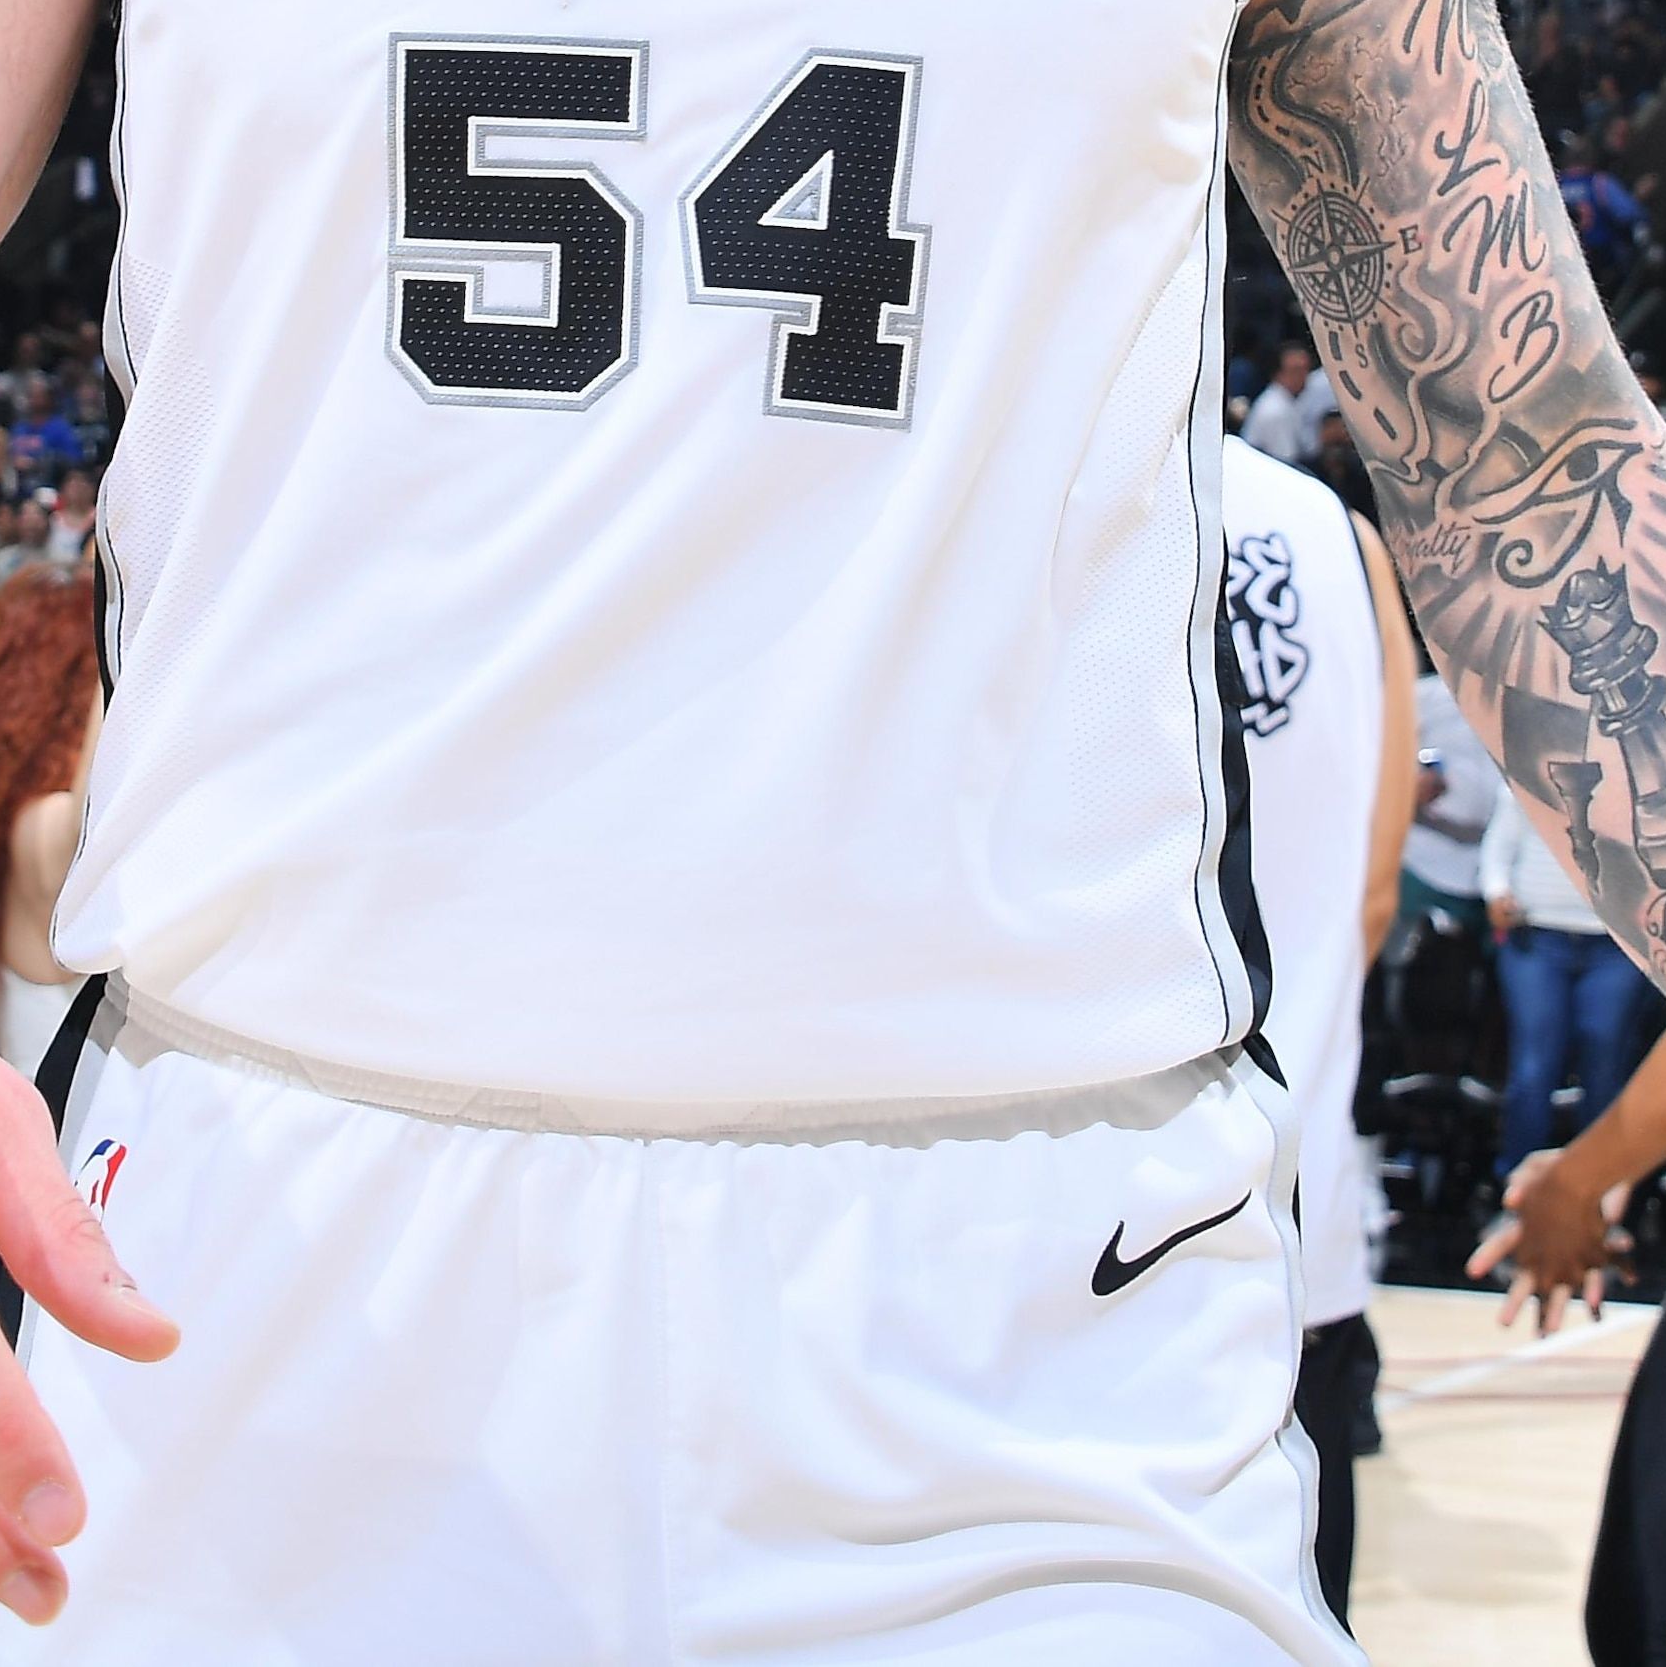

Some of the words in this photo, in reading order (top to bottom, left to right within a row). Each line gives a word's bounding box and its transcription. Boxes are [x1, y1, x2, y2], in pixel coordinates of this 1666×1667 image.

[384, 32, 931, 432] 54
[1399, 225, 1422, 254] E
[1355, 344, 1369, 369] S
